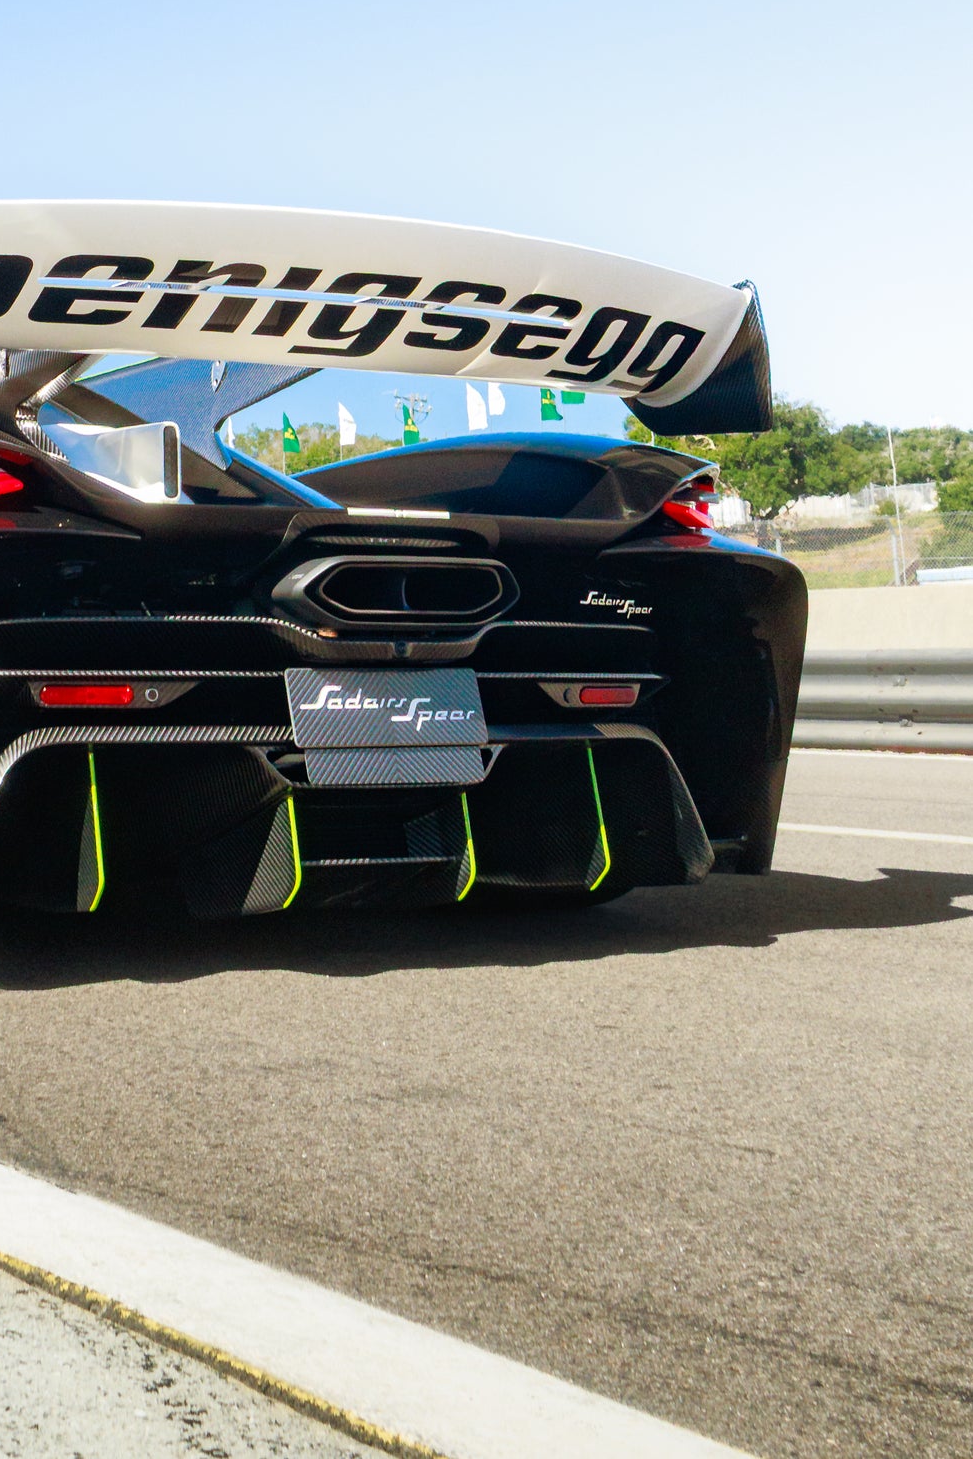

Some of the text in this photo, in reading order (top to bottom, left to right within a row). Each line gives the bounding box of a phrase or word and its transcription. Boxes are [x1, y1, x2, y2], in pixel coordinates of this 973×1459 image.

[616, 600, 653, 619] Spear
[299, 685, 476, 732] Sadairs Spear
